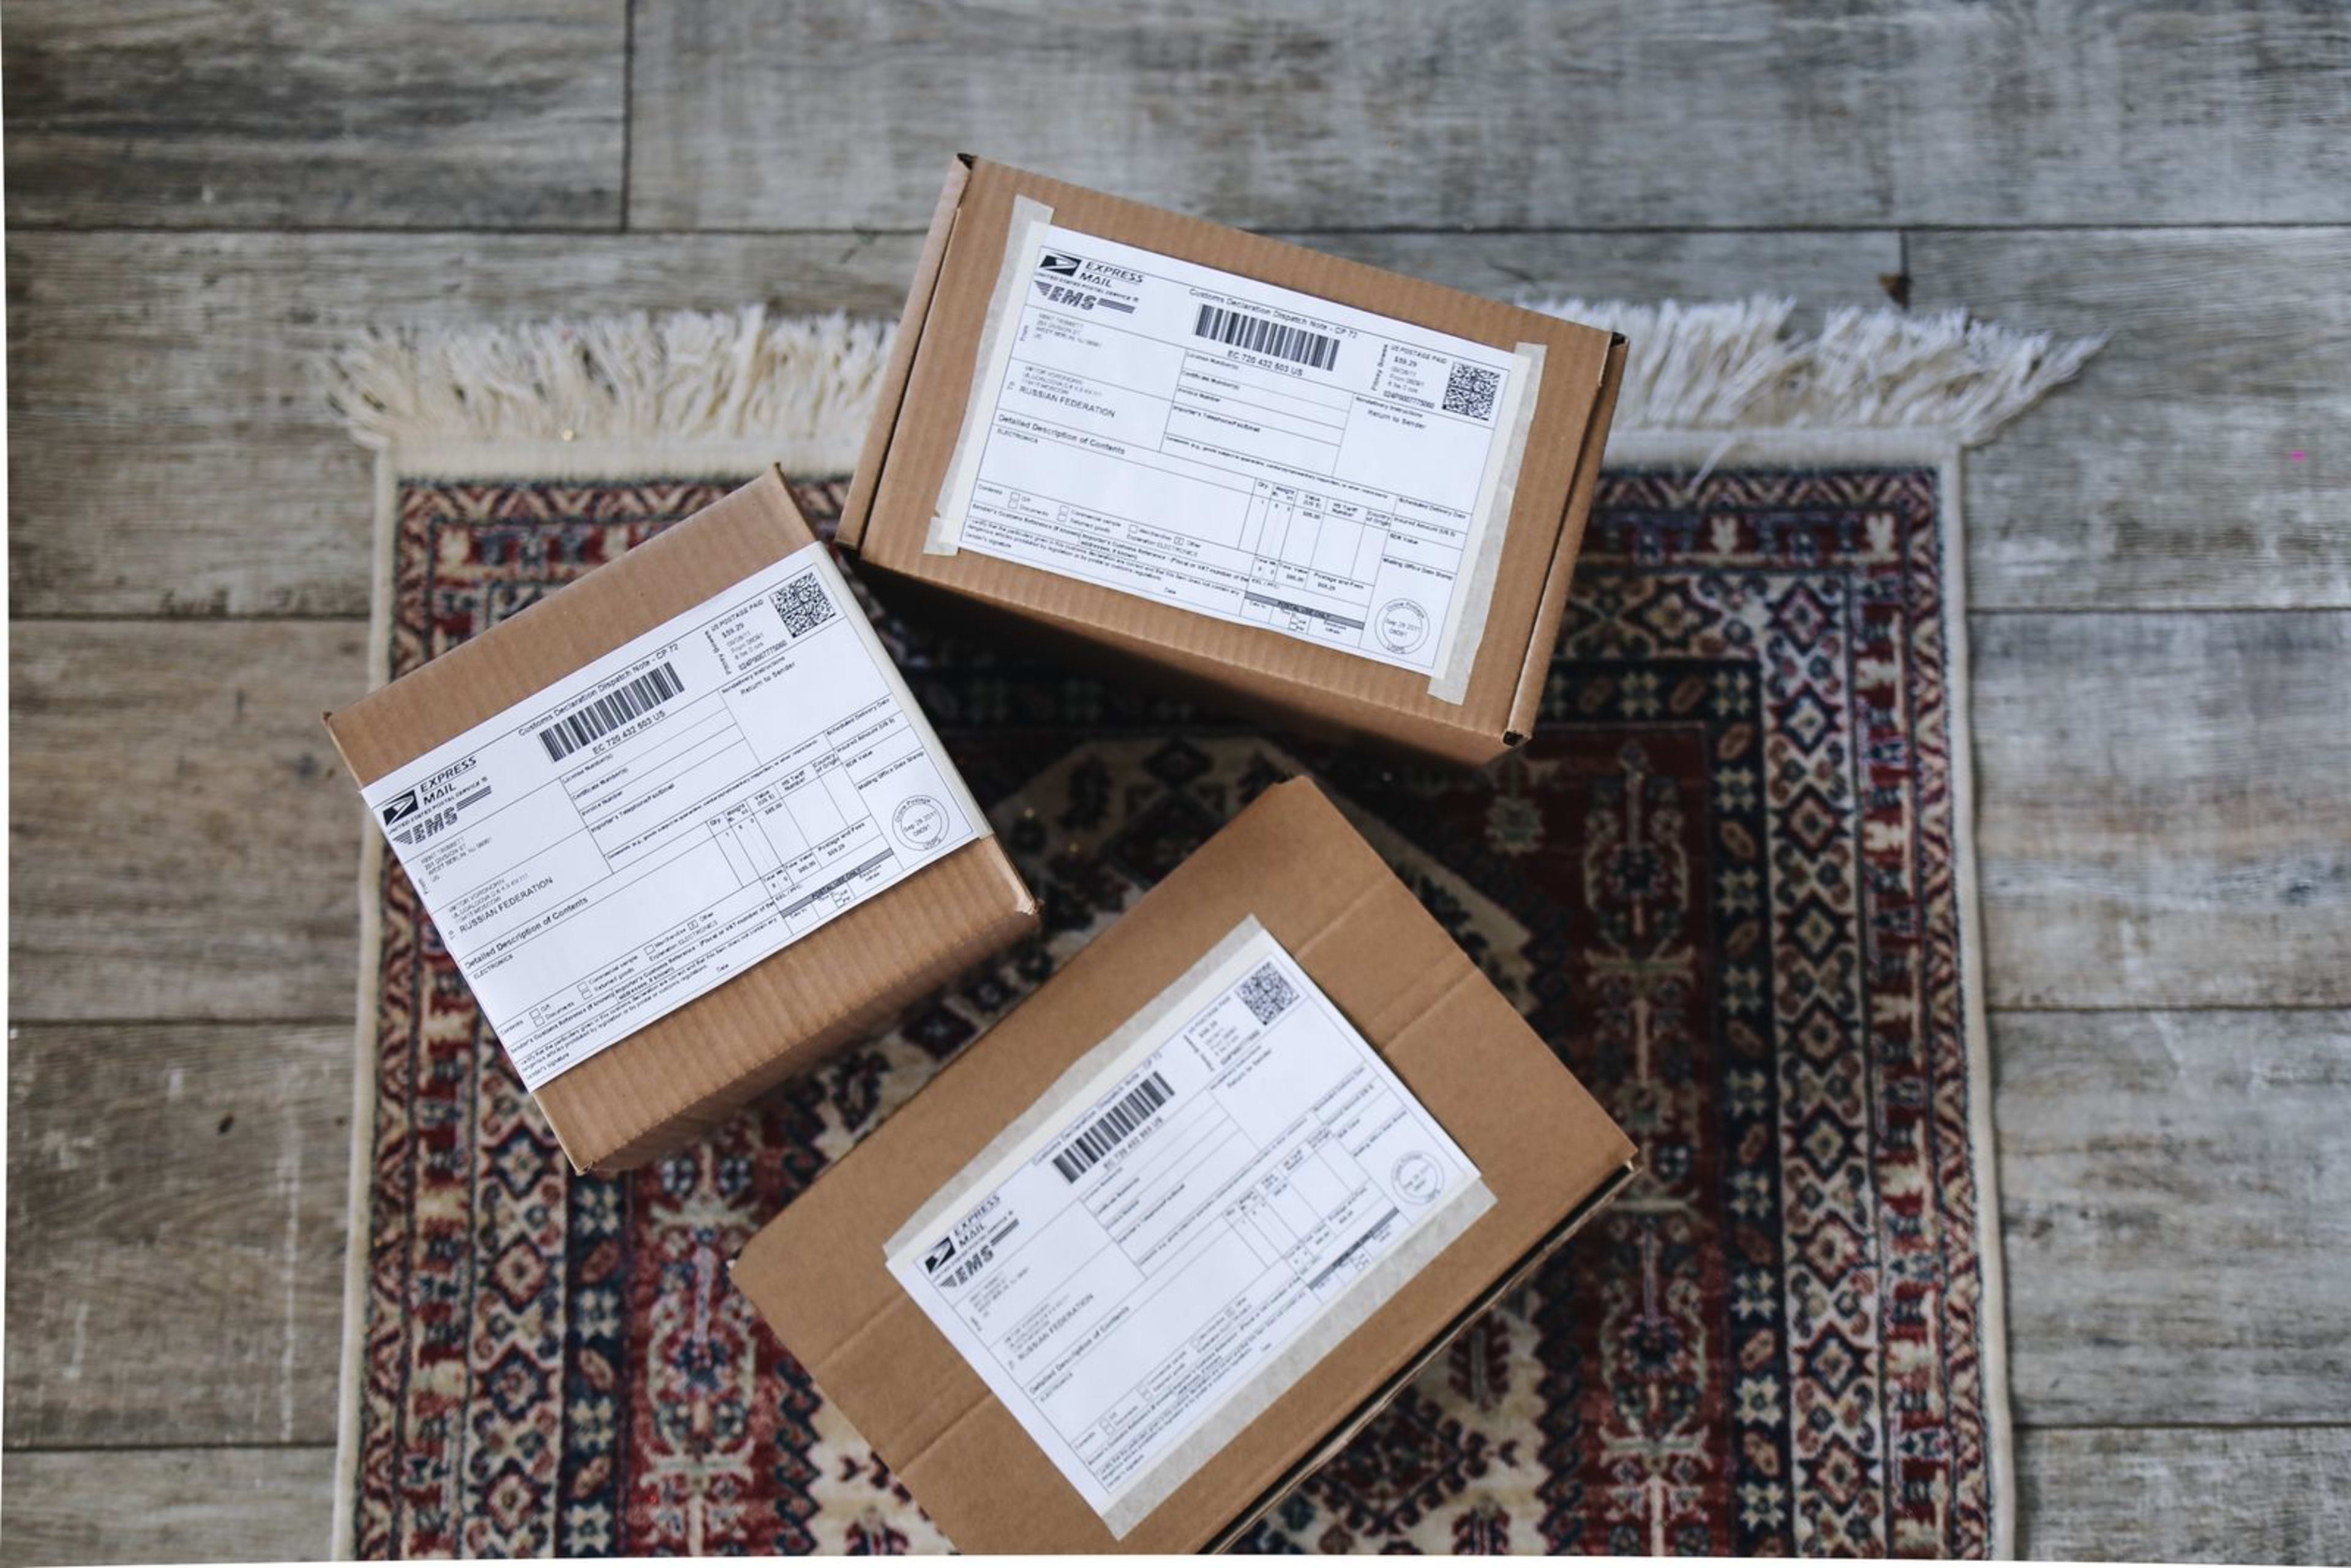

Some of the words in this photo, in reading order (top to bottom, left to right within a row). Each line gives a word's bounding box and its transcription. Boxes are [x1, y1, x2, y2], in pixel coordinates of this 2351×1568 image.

[1079, 272, 1111, 287] MAIL
[1085, 261, 1143, 283] EXPRESS
[1048, 284, 1097, 310] EMS
[1188, 287, 1224, 304] Customs
[1226, 297, 1271, 314] Declaration
[1273, 309, 1307, 324] Dispatch
[1310, 320, 1328, 331] Note
[1227, 350, 1239, 359] EC
[1290, 367, 1303, 377] US
[1019, 385, 1058, 402] RUSSIAN
[1059, 396, 1116, 418] FEDERATION
[998, 413, 1031, 429] Detailed
[1031, 422, 1078, 441] Description
[1079, 436, 1089, 445] of
[1089, 438, 1125, 455] Contents
[517, 713, 554, 737] Customs
[553, 689, 597, 716] Declaration
[597, 670, 631, 692] Dispatch
[631, 659, 651, 673] Note
[655, 648, 669, 661] CP
[667, 642, 680, 653] 72
[739, 679, 763, 696] Return
[762, 674, 773, 683] to
[771, 661, 795, 678] Sender
[591, 743, 606, 755] EC
[605, 733, 621, 746] 720
[622, 725, 637, 738] 432
[637, 716, 653, 730] 503
[651, 709, 666, 721] US
[419, 756, 477, 793] EXPRESS
[422, 782, 456, 806] MAIL
[407, 806, 458, 844] EMS
[459, 907, 498, 932] RUSSIAN
[497, 876, 553, 912] FEDERATION
[465, 947, 497, 969] Detailed
[495, 923, 542, 951] Description
[541, 915, 552, 926] of
[552, 897, 588, 920] Contents
[953, 1195, 1000, 1237] EXPRESS
[958, 1221, 986, 1248] MAIL
[951, 1244, 994, 1285] EMS
